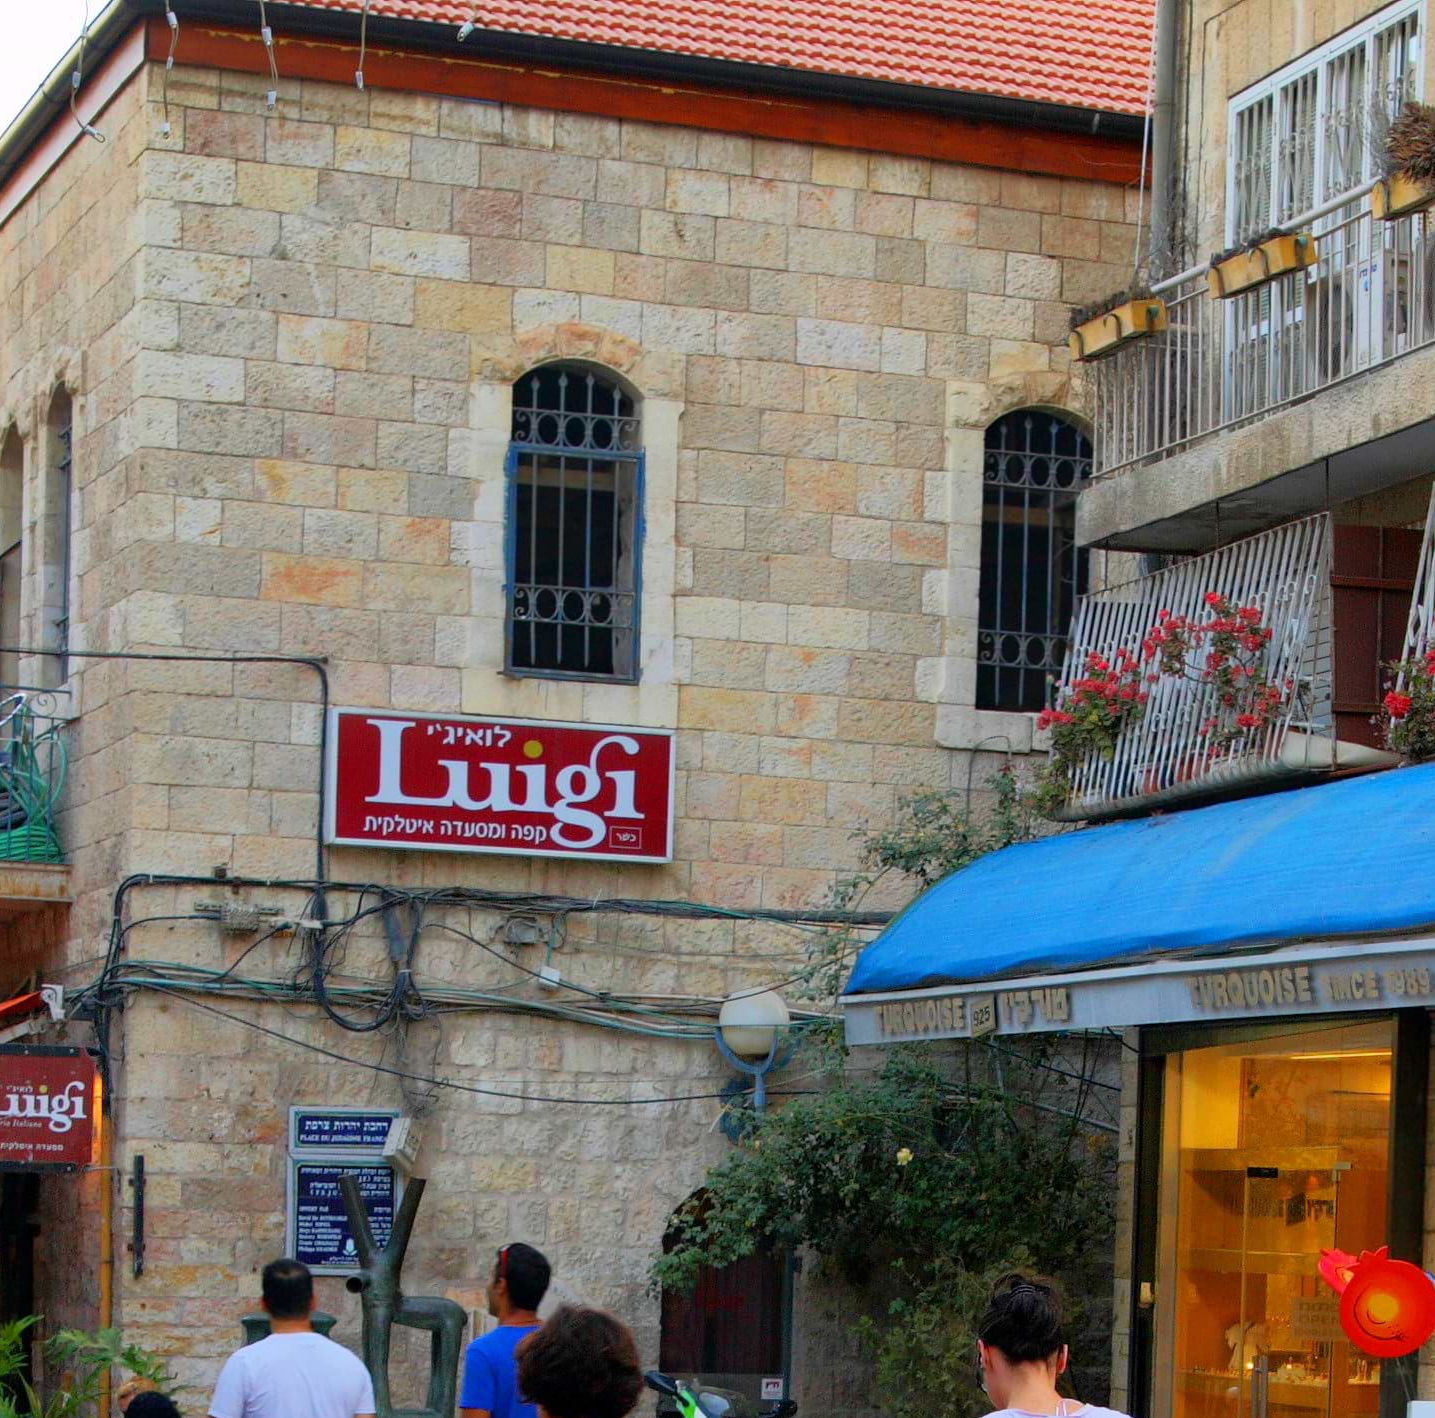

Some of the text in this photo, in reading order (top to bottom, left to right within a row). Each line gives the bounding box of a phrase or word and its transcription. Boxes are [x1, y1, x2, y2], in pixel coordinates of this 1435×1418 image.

[364, 719, 646, 849] Luigi
[363, 814, 548, 845] קפה ומסעדה איטלקית
[1186, 966, 1433, 1010] TURQUOISE SINCE 1989
[876, 997, 964, 1034] TURQUOISE
[972, 1005, 991, 1028] 925
